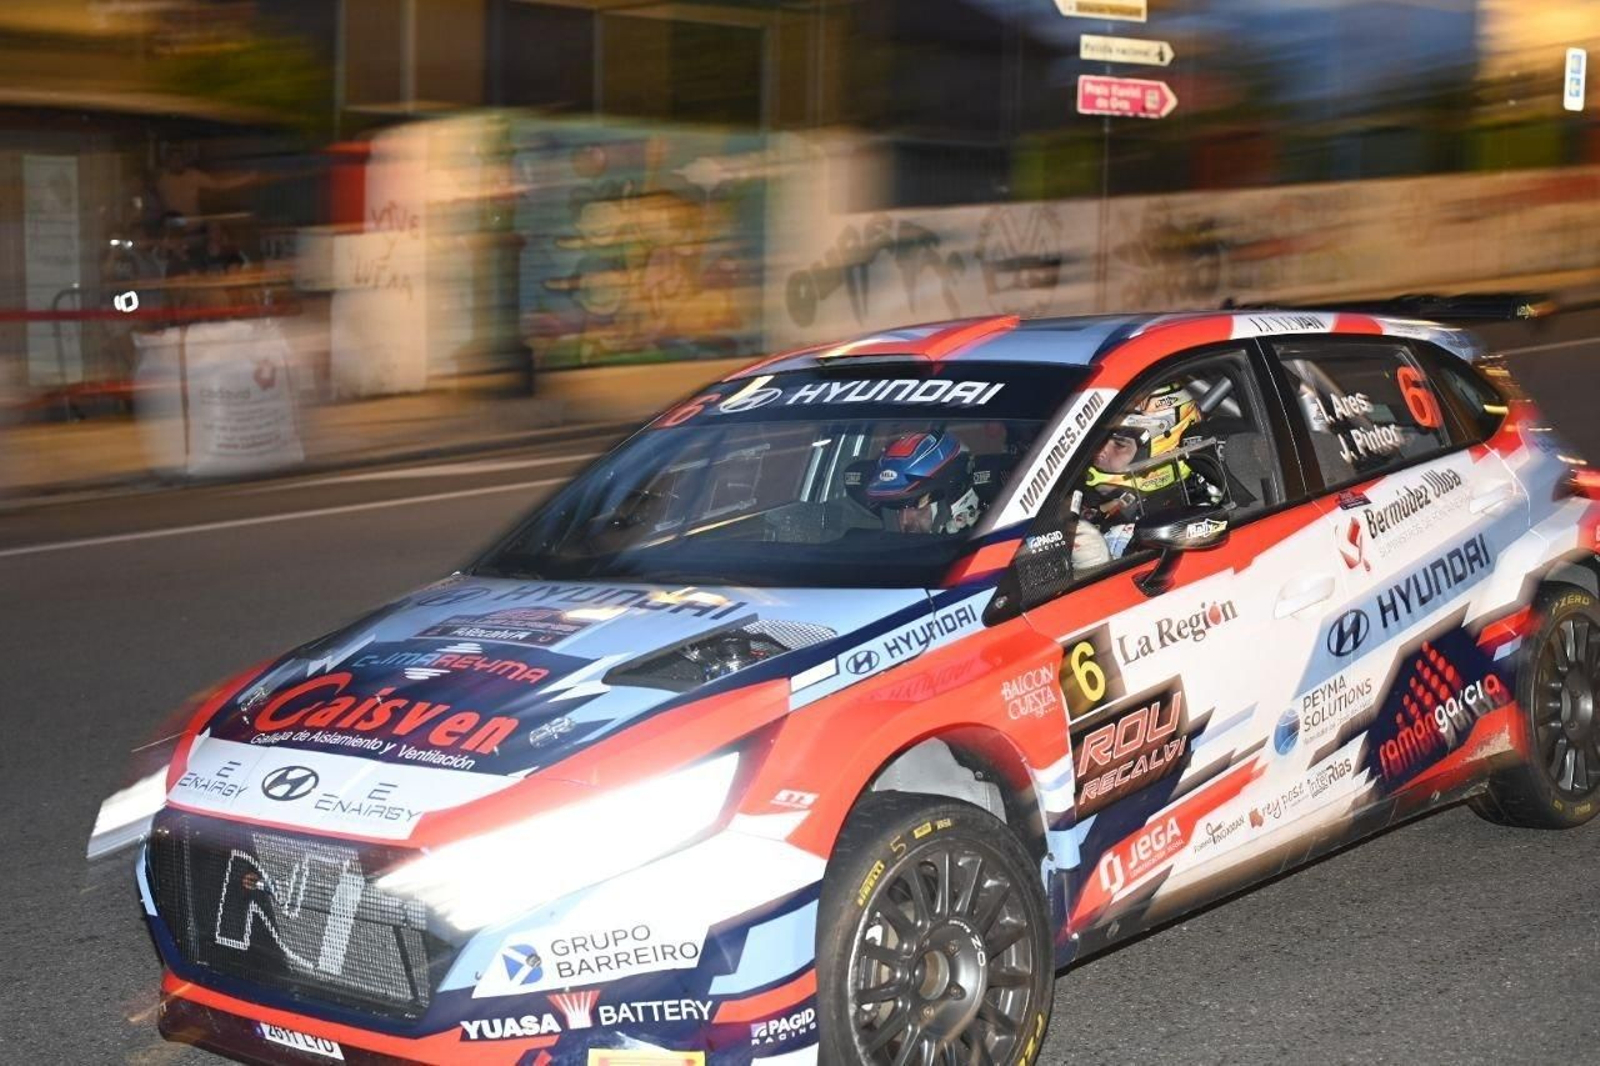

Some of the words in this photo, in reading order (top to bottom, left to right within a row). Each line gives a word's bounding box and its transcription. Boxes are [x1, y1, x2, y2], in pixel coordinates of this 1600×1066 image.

[785, 379, 1006, 405] HYUNDAI
[1330, 392, 1374, 420] Ares
[1397, 365, 1443, 430] 6
[1350, 424, 1401, 457] Pintor
[1036, 530, 1064, 548] PAGID
[1377, 533, 1490, 629] HYUNDAI
[492, 585, 747, 621] HYUNDAI
[884, 604, 977, 659] HYUNDAI
[1117, 634, 1155, 665] La
[1071, 641, 1106, 702] 6
[1303, 675, 1346, 712] PEYMA
[1304, 678, 1372, 732] SOLUTIONS
[292, 729, 311, 743] de
[310, 729, 383, 751] Aislamiento
[382, 743, 396, 756] y
[397, 744, 476, 770] Ventilación
[1077, 691, 1182, 778] ROU
[1079, 735, 1186, 805] RECALVI
[314, 793, 422, 821] ENAIRGY
[890, 835, 907, 860] 5
[550, 924, 651, 957] GRUPO
[556, 941, 699, 979] BARREIRO
[460, 1013, 563, 1041] YUASA
[598, 999, 713, 1027] BATTERY
[751, 1021, 817, 1046] RACING
[768, 1008, 816, 1036] PAGID
